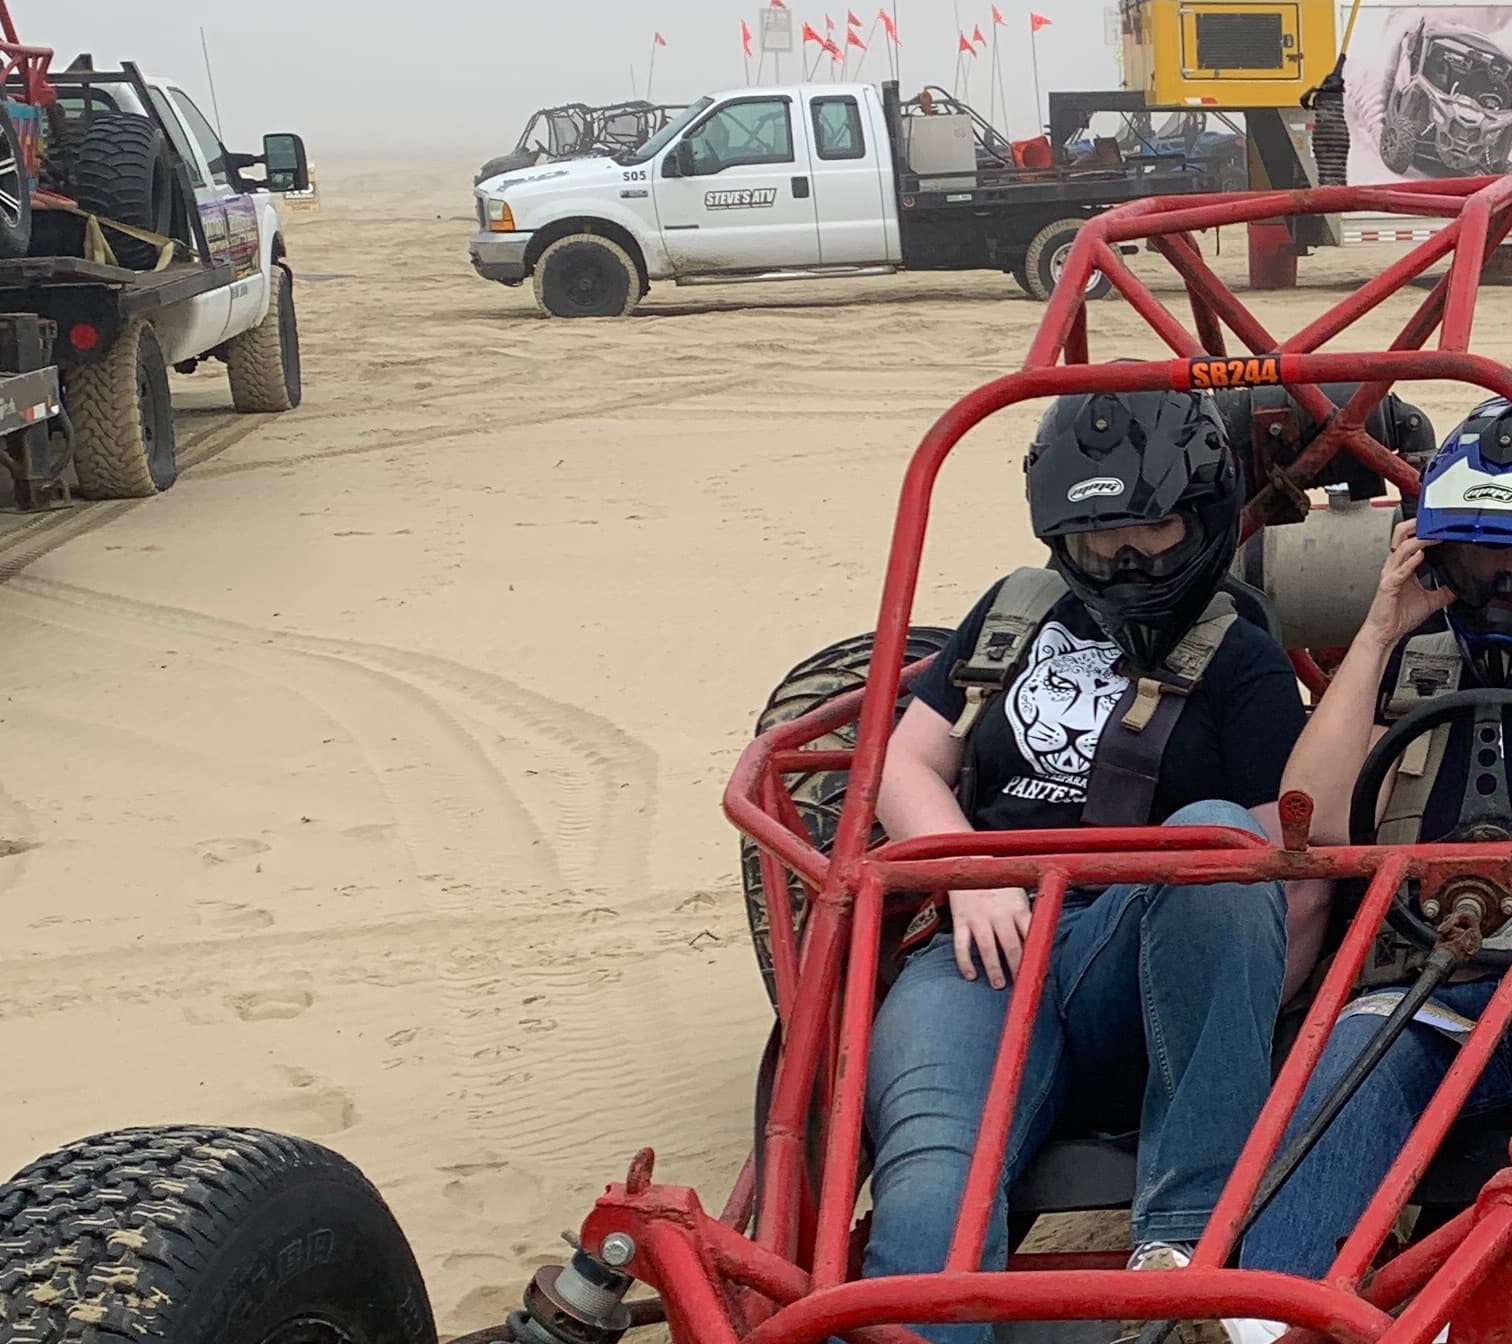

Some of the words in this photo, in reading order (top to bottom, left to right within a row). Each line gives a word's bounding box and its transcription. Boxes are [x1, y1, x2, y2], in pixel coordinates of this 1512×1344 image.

[704, 190, 753, 206] STEVE'S
[752, 188, 776, 204] ATV
[1192, 358, 1279, 388] SB244
